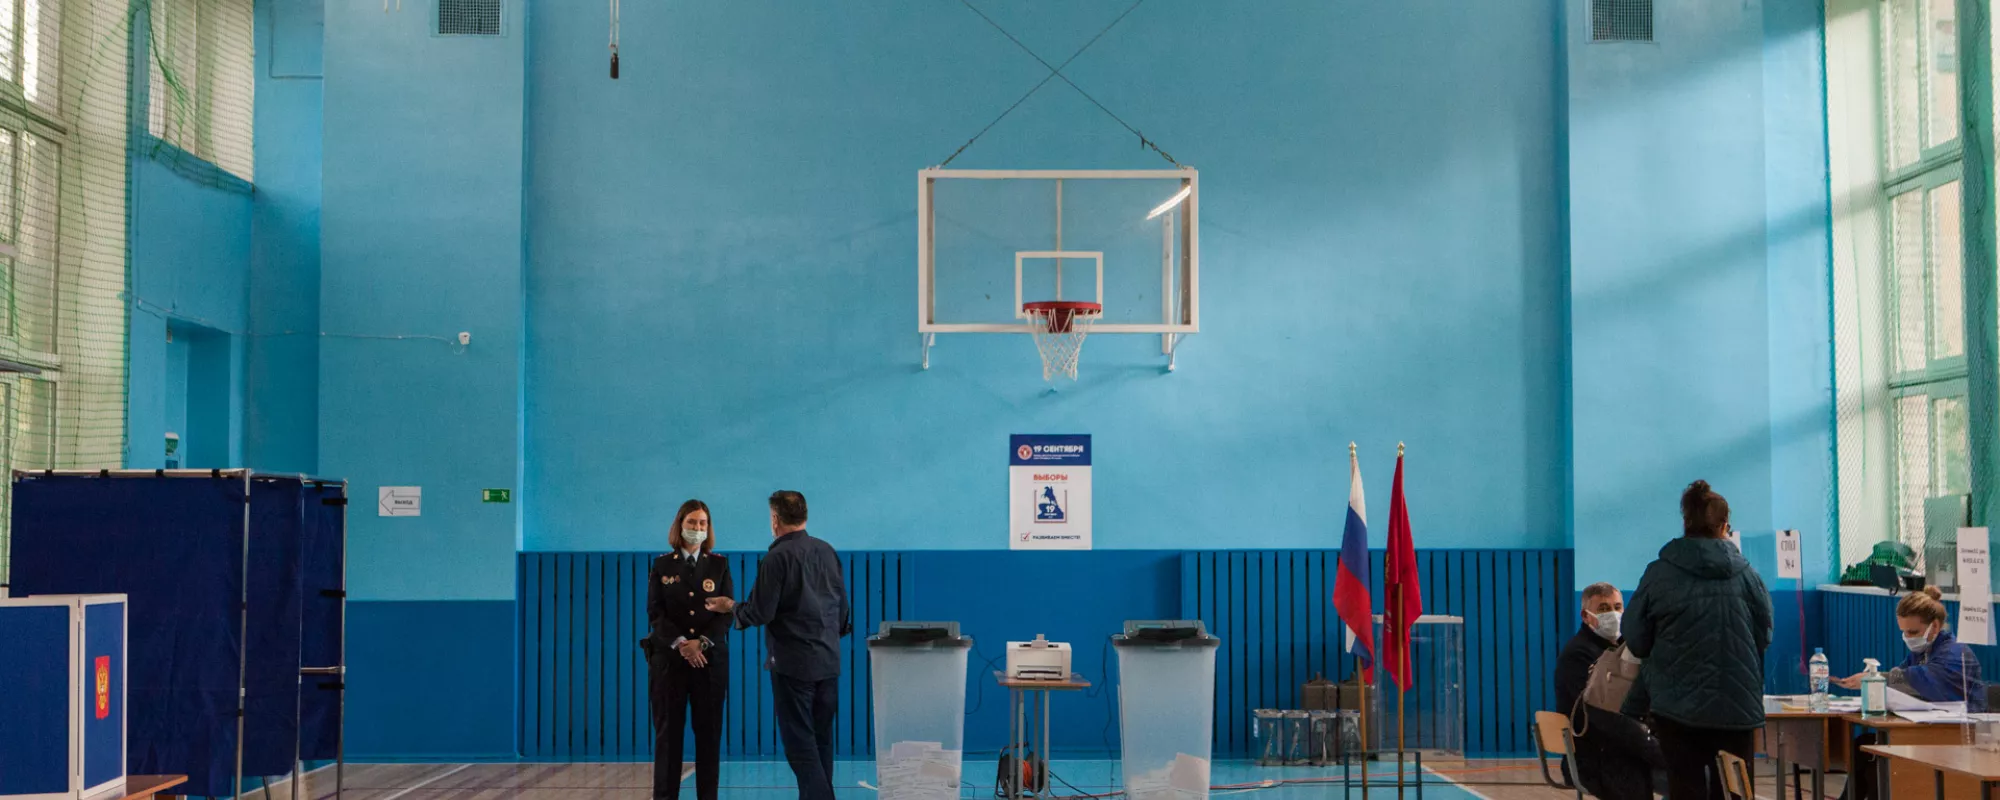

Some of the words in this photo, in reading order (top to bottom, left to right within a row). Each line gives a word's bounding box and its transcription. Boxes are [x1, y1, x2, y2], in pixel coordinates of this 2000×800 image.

[1033, 445, 1042, 453] 19
[1043, 445, 1084, 453] СЕНТЯБРЯ
[1046, 505, 1056, 513] 19
